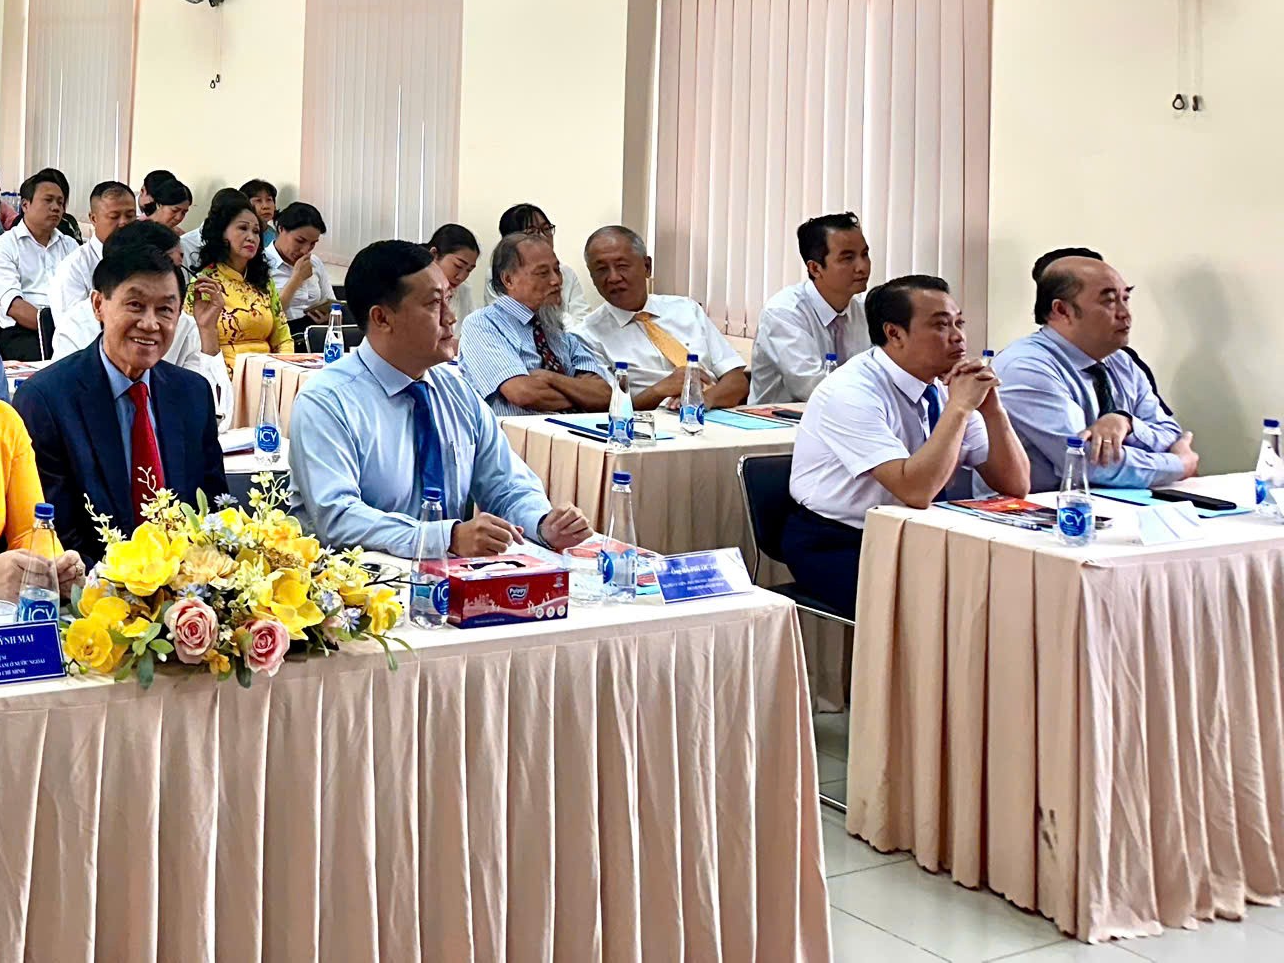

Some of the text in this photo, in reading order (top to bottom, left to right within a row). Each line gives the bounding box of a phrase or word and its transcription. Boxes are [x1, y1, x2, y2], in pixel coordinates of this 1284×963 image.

[259, 430, 277, 442] ICY
[437, 585, 449, 602] IC
[17, 634, 34, 644] MAI
